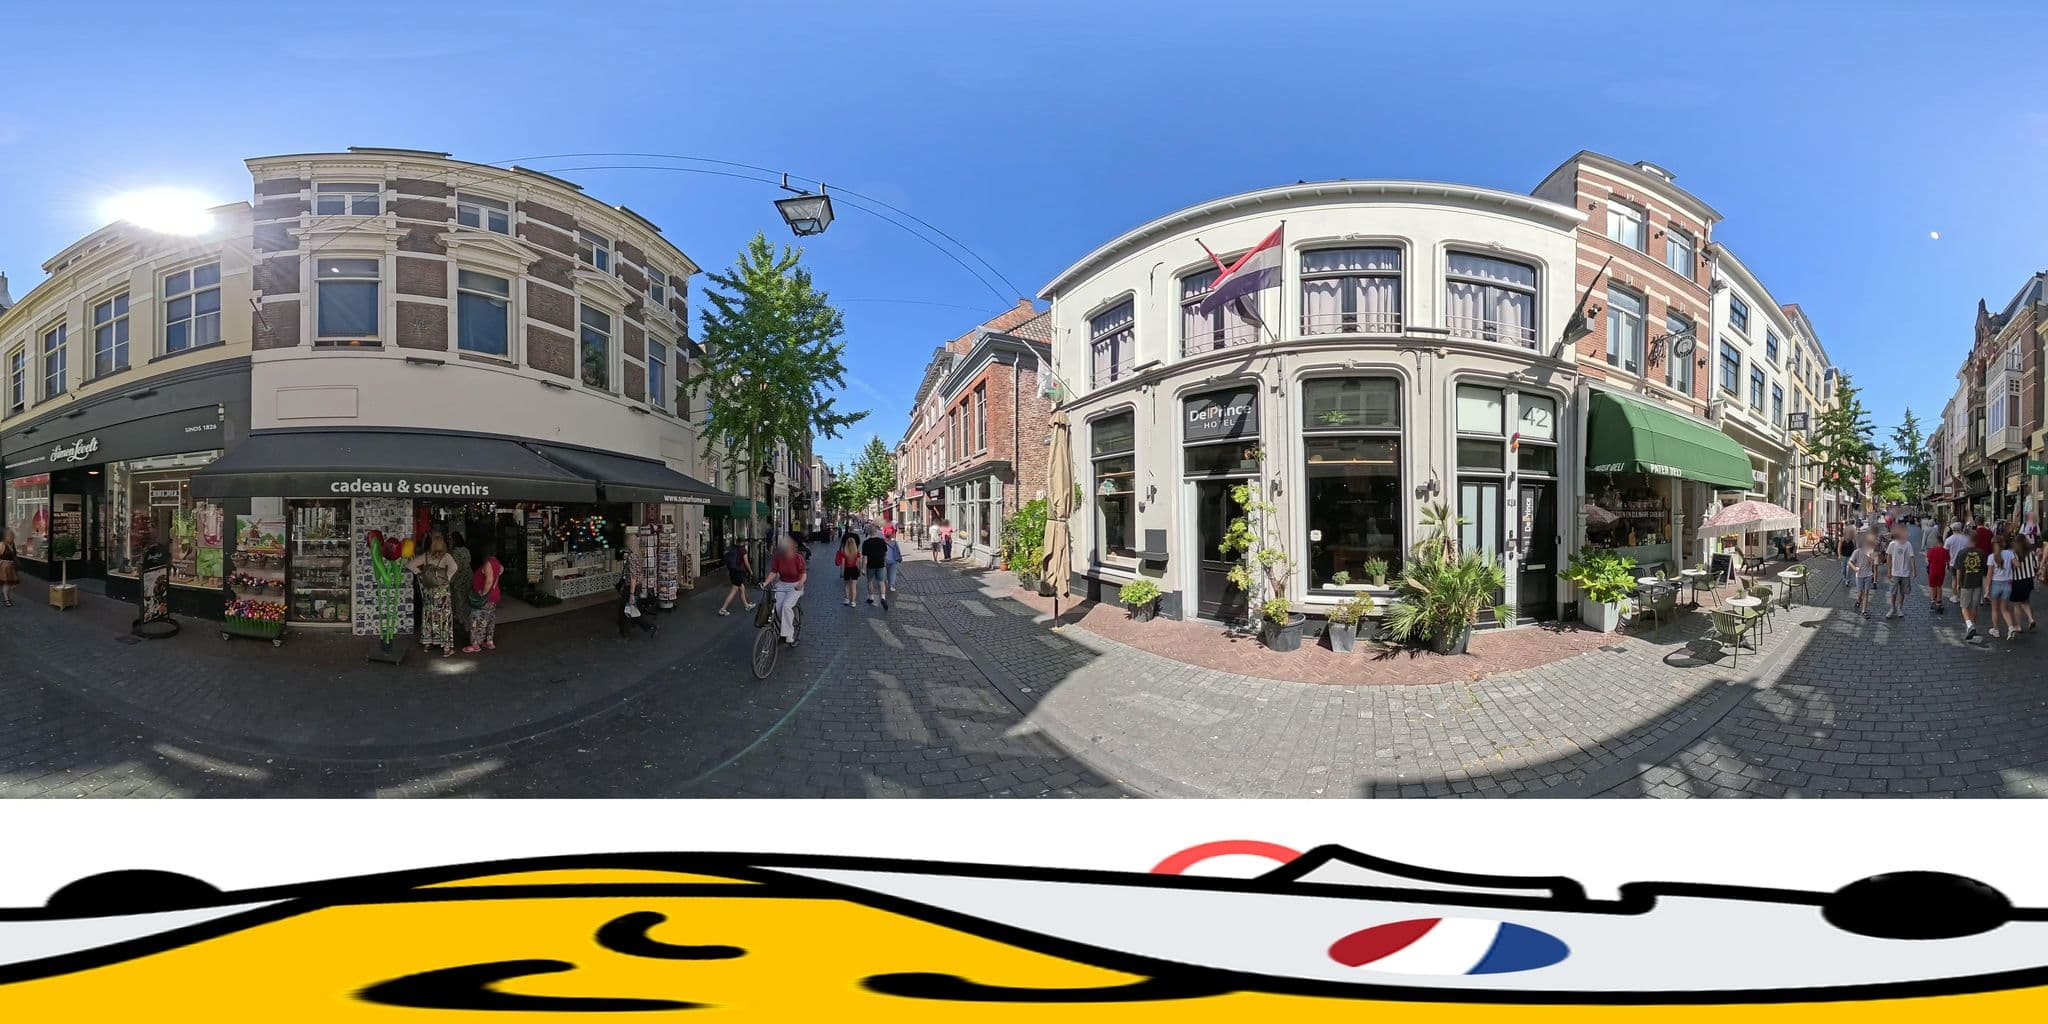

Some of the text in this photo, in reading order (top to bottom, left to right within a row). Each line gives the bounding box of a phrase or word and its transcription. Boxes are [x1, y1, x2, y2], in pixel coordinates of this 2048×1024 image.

[1522, 406, 1549, 428] 42
[1650, 464, 1682, 477] PATER DELI
[330, 478, 489, 496] cadeau & souvenirs
